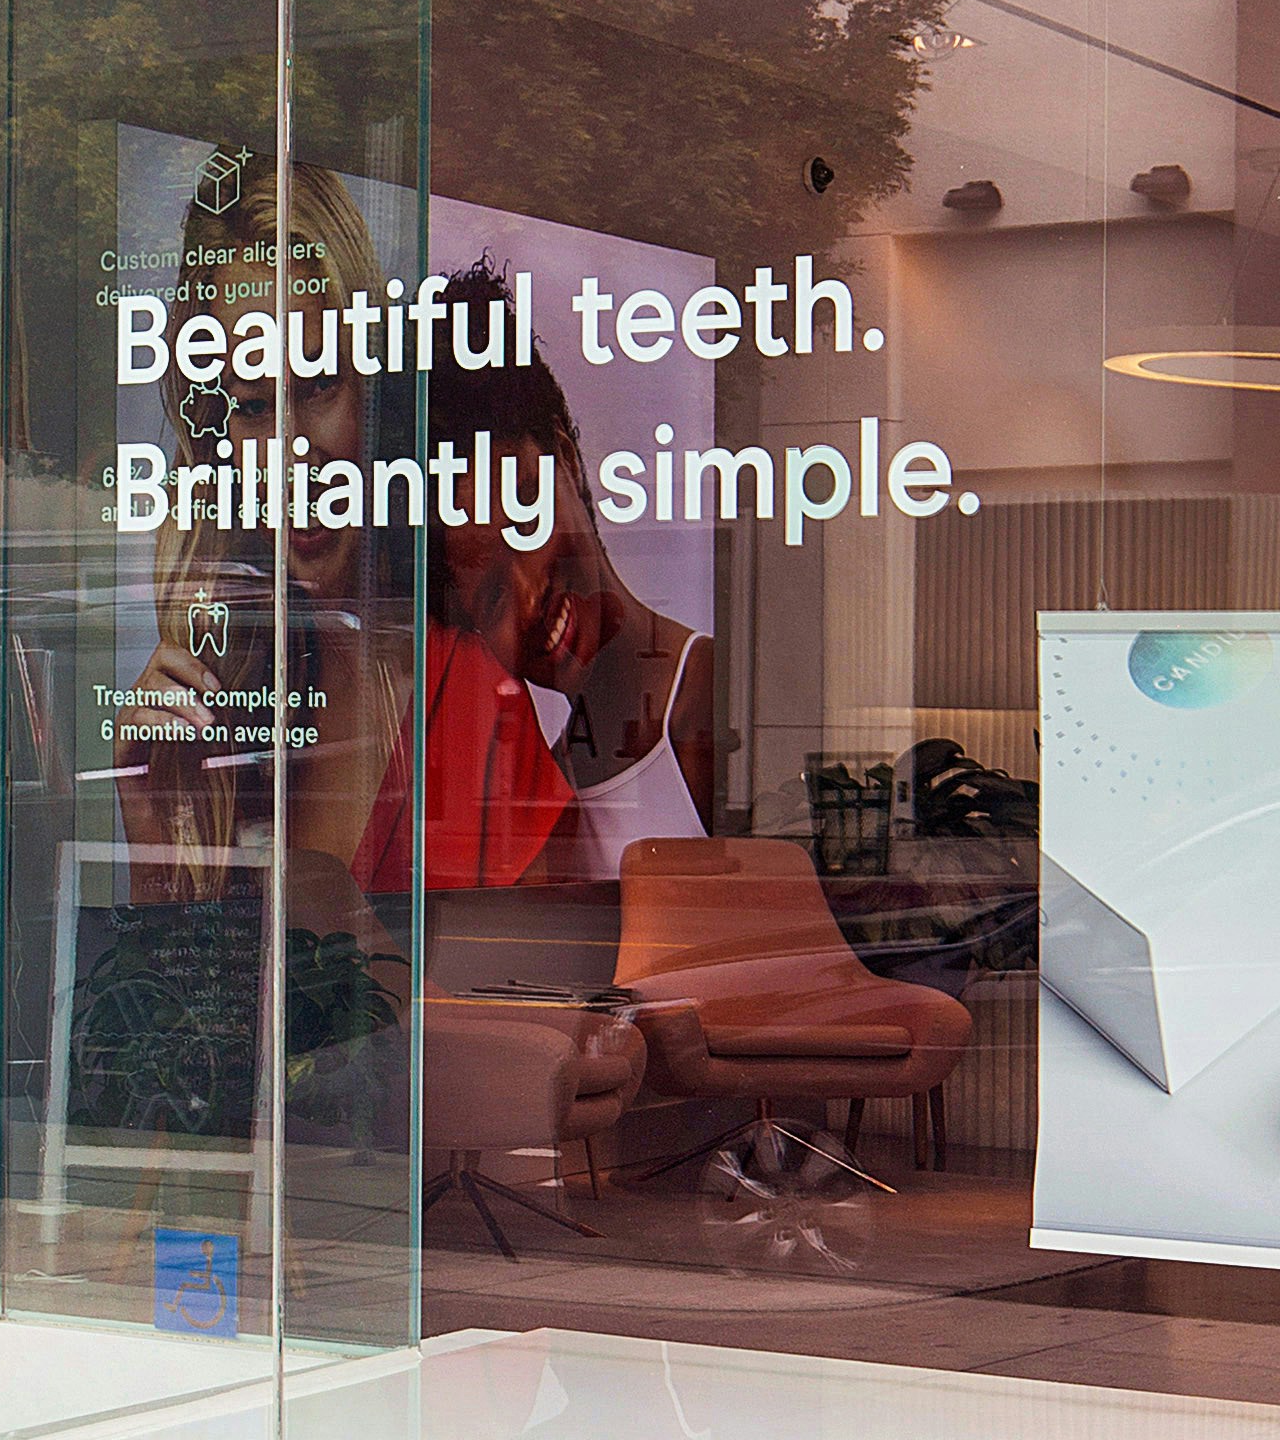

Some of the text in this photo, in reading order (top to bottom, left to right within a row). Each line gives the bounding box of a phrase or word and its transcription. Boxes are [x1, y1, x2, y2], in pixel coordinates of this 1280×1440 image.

[100, 250, 180, 271] Custom
[186, 244, 236, 267] clear
[196, 281, 217, 300] to
[224, 280, 273, 304] your
[117, 255, 885, 384] Beautiful teeth.
[117, 418, 981, 551] Brilliantly simple.
[93, 685, 327, 712] Treatment complee in
[101, 718, 114, 741] 6
[119, 720, 195, 742] months
[201, 723, 228, 742] on
